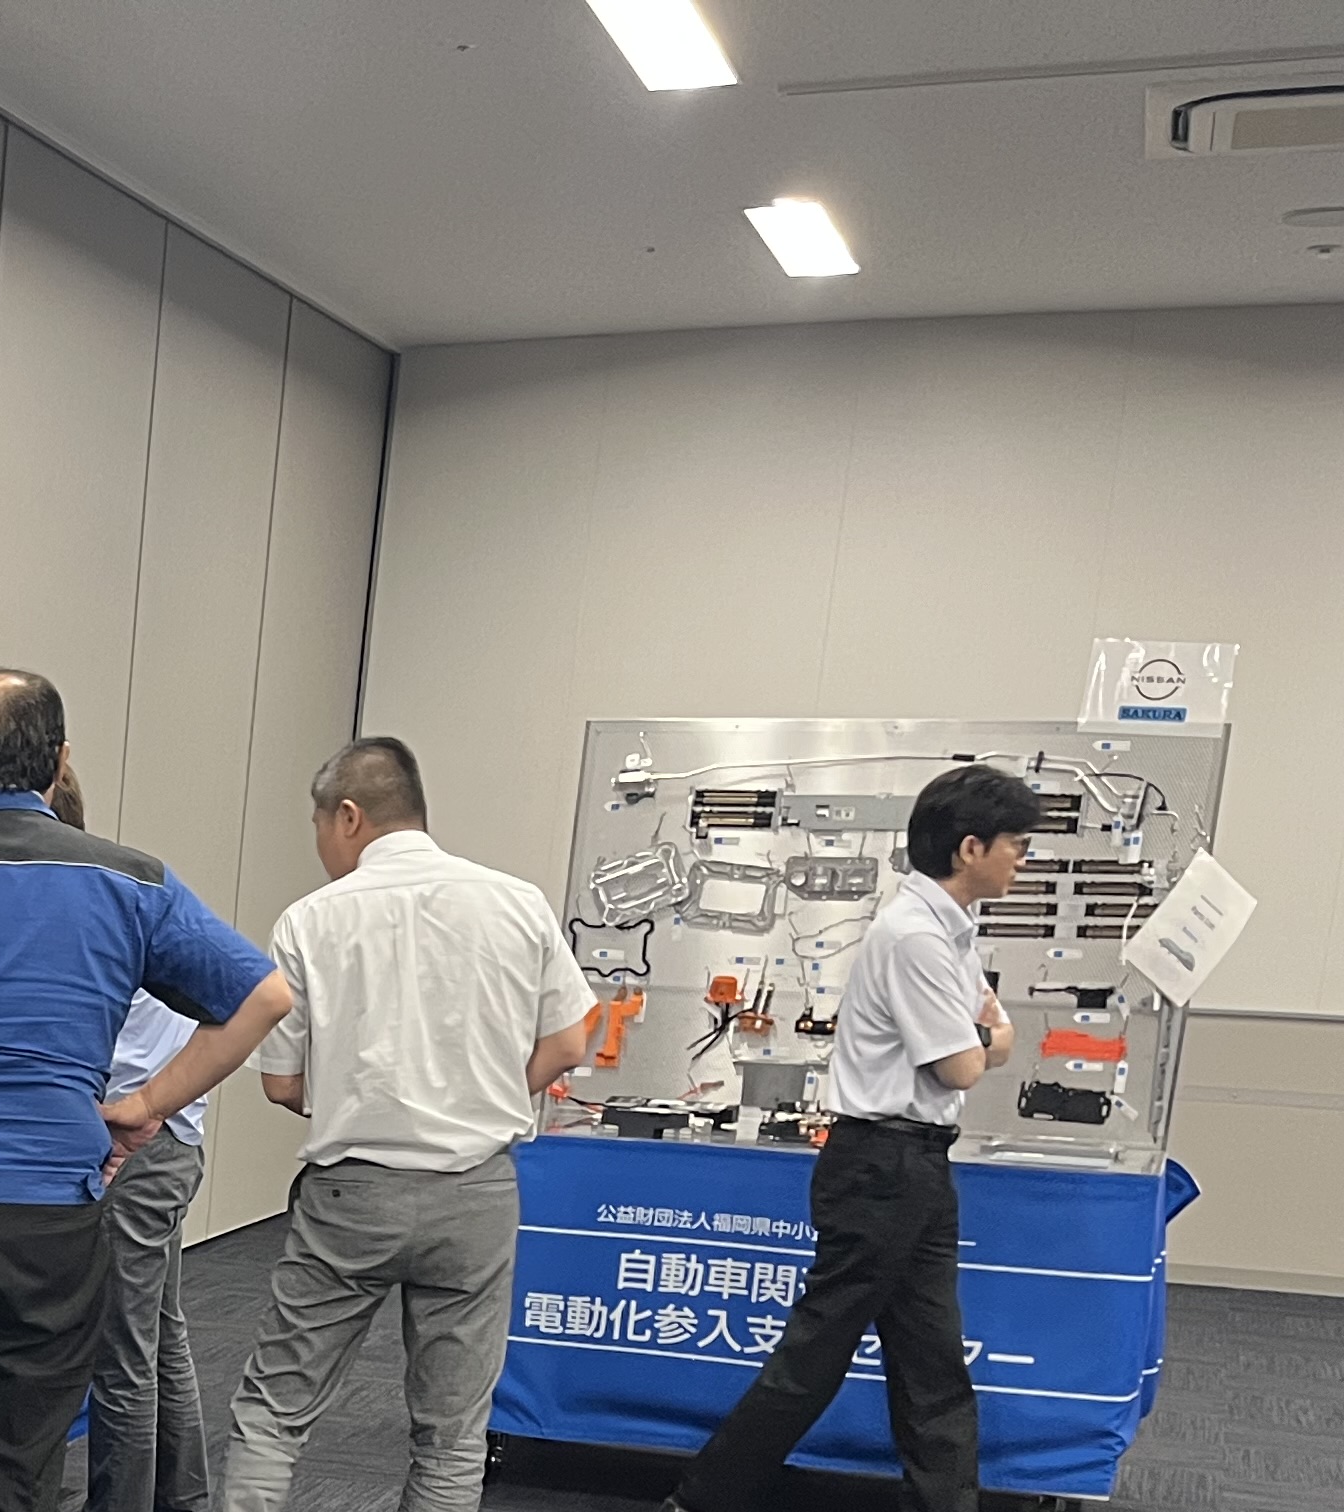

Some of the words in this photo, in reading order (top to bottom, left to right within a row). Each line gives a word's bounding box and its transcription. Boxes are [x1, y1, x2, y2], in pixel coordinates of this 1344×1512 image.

[1131, 675, 1186, 685] NISSAN
[1120, 708, 1183, 720] SAKURA
[617, 1249, 809, 1308] 自動車関
